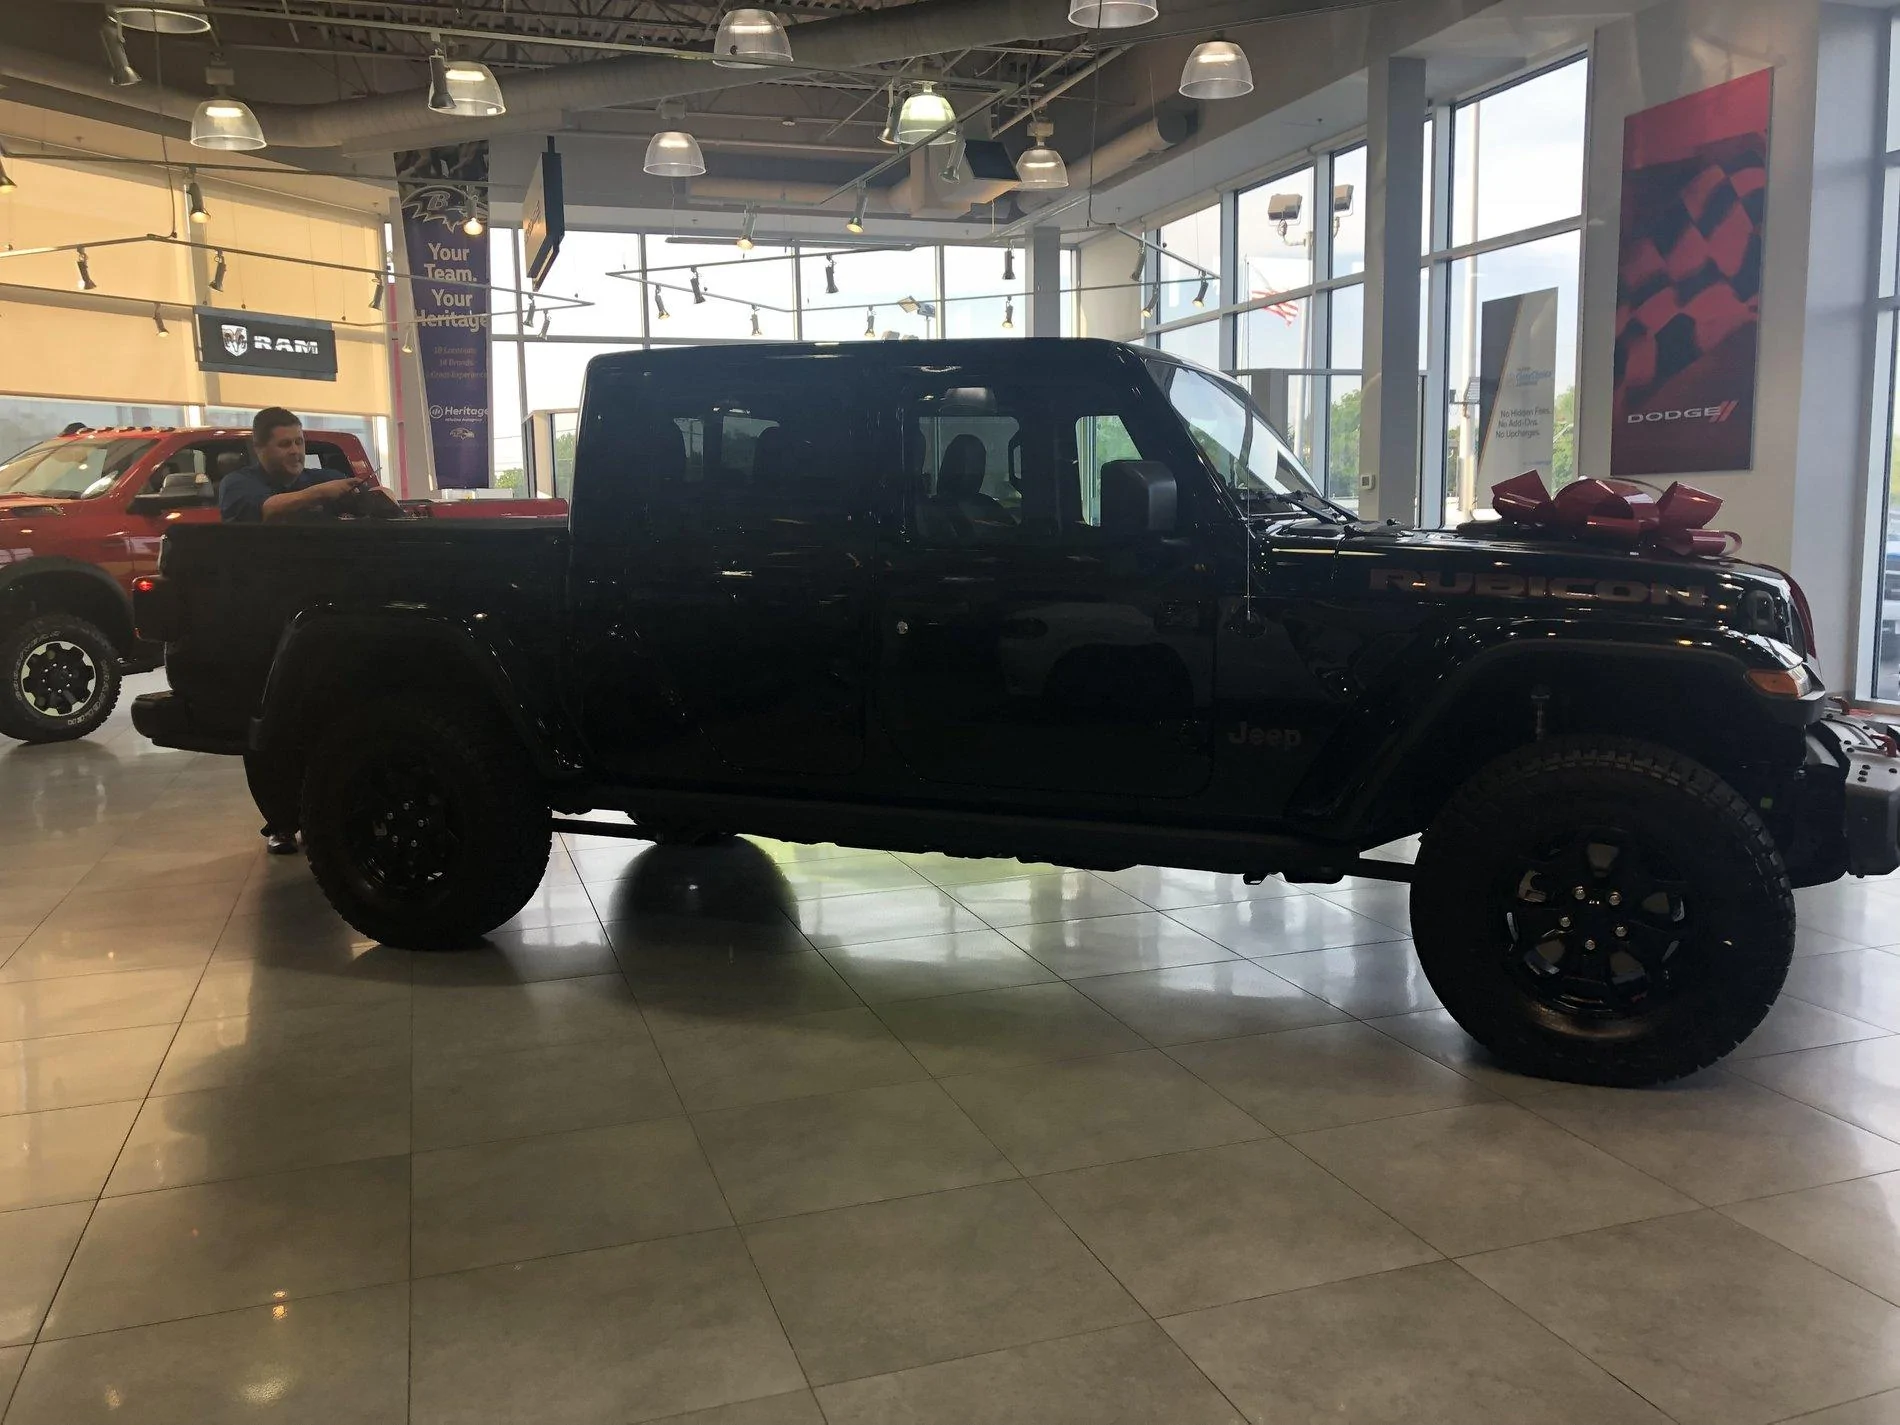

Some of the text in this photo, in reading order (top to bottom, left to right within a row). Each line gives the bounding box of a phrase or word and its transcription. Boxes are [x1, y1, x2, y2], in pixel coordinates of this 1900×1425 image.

[428, 242, 470, 262] Your
[424, 263, 477, 283] Team.
[431, 288, 473, 308] Your
[415, 309, 489, 333] Heritage
[253, 335, 319, 355] RAM
[1500, 410, 1510, 418] No
[1511, 408, 1534, 417] Hidden
[1627, 406, 1722, 424] DODGE
[1496, 430, 1505, 438] No
[1498, 420, 1507, 428] No
[1368, 568, 1706, 607] RUBICON
[1226, 720, 1303, 751] Jeep
